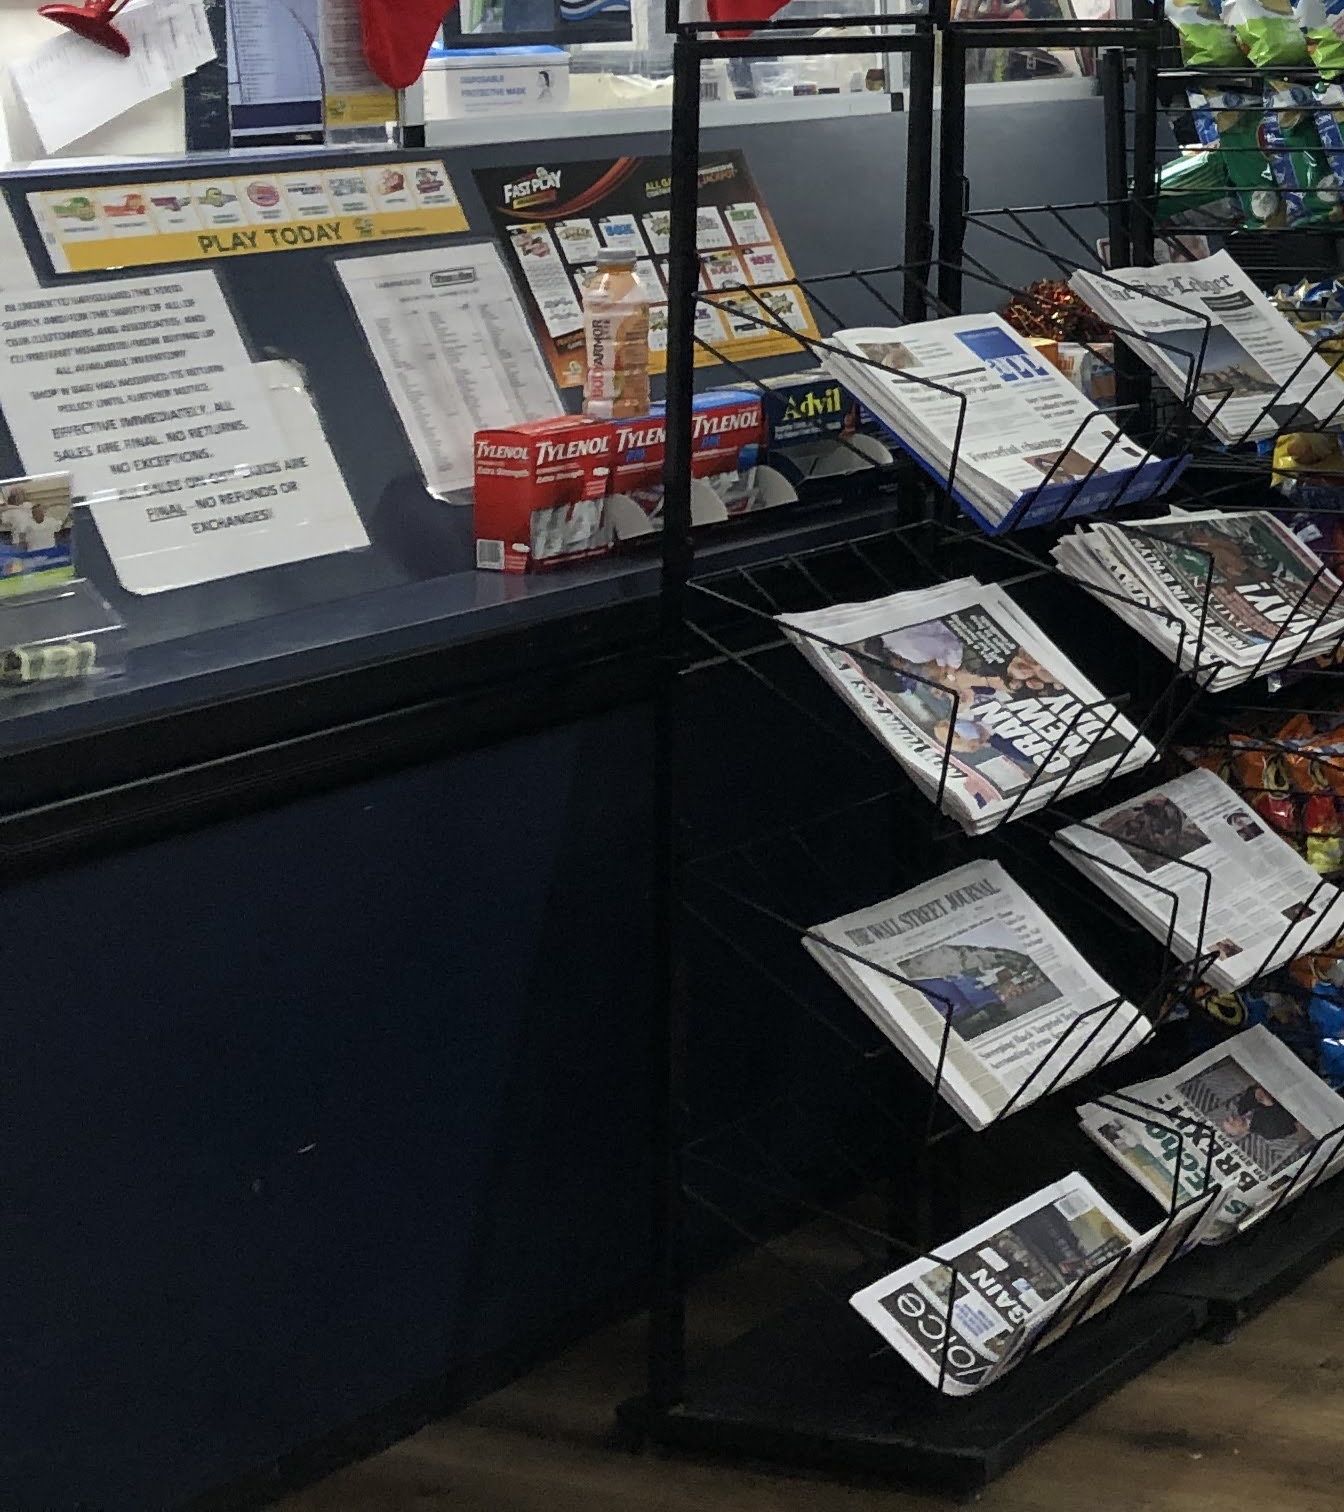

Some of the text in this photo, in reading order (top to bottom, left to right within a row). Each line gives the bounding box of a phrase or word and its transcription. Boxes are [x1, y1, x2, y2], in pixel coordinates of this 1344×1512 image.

[198, 222, 343, 255] PLAY TODAY
[782, 387, 843, 422] Advil
[616, 424, 666, 453] TYLEN
[693, 411, 760, 440] TYLENOL
[476, 441, 530, 461] TYLENOL
[536, 434, 611, 465] TYLENOL
[109, 461, 130, 474] NO
[968, 695, 1072, 775] GRAN
[867, 918, 901, 942] WALL
[898, 899, 949, 936] STREET
[941, 878, 1002, 913] JOURNAL
[969, 1267, 1028, 1324] GAIN
